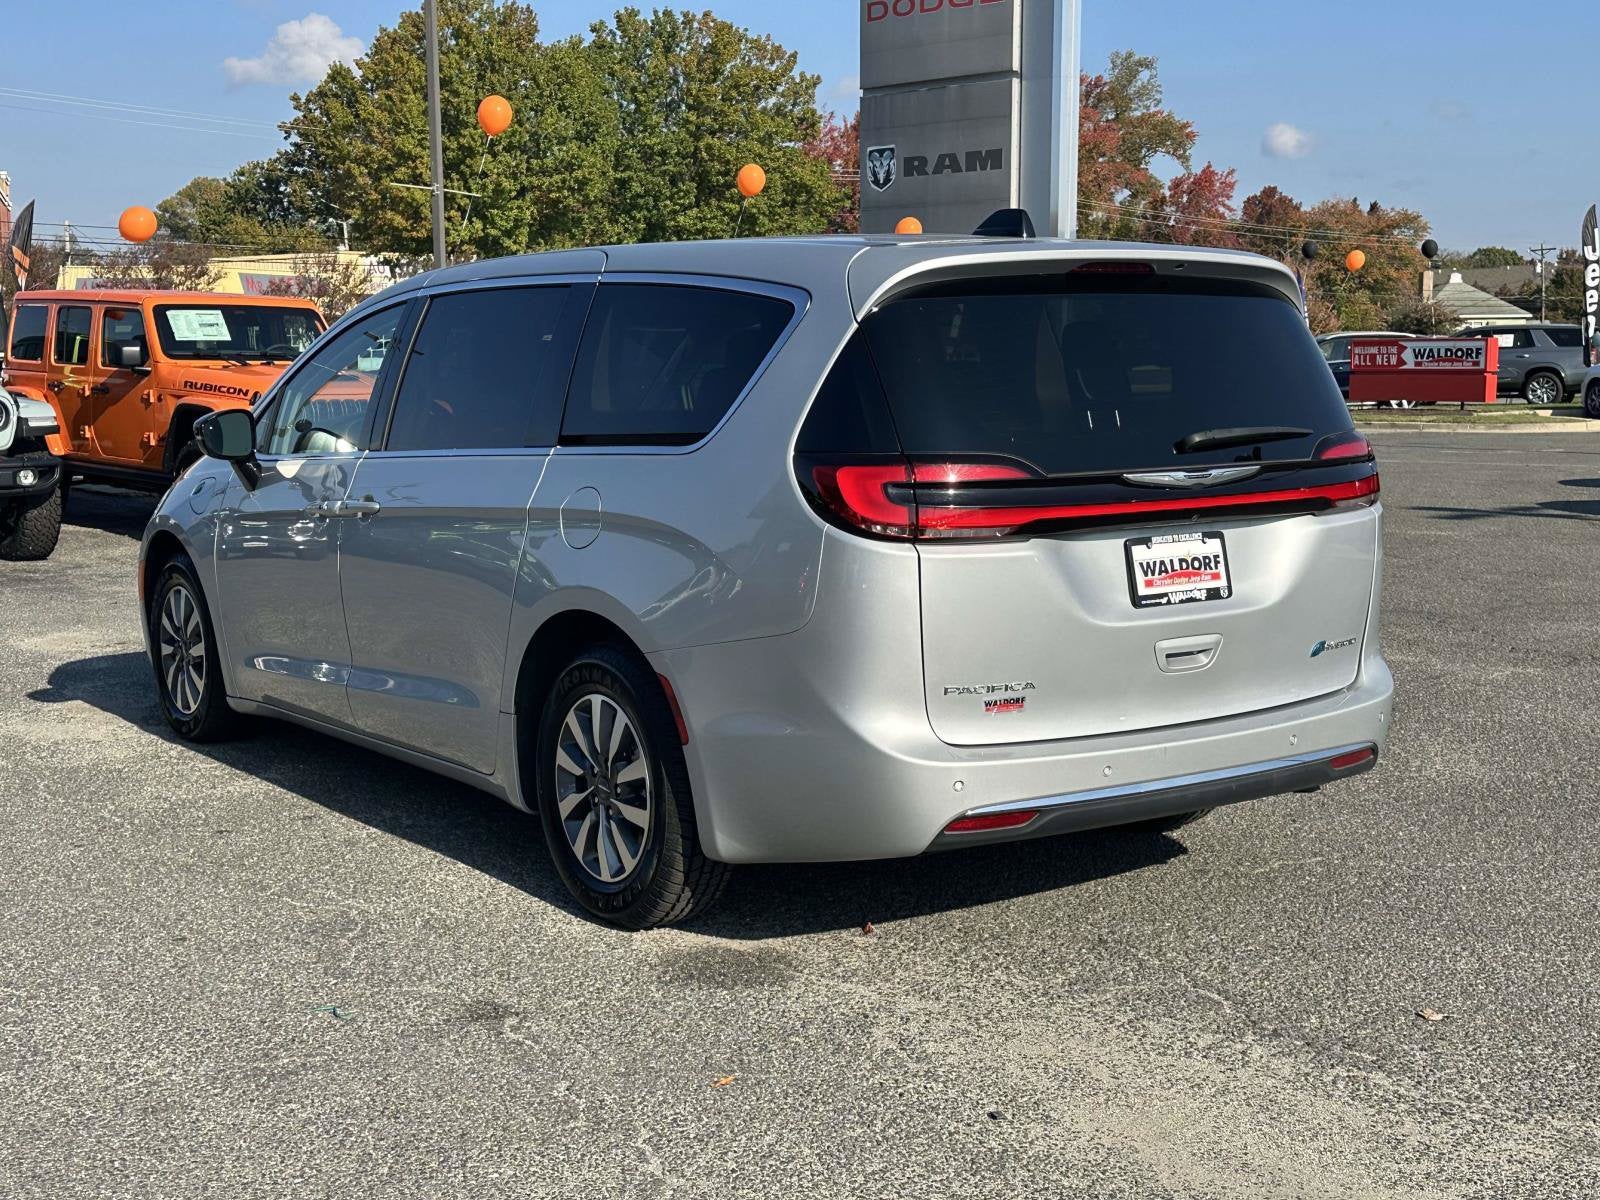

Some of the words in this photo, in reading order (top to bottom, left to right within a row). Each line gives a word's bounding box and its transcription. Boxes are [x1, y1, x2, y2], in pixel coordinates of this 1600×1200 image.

[866, 0, 1004, 23] DOD
[903, 148, 1003, 178] RAM
[1354, 346, 1379, 354] WELCOME
[1380, 346, 1387, 354] TO
[1388, 346, 1398, 354] THE
[1412, 347, 1483, 360] WALDORF
[1354, 354, 1372, 366] ALL
[1376, 354, 1398, 366] NEW
[183, 380, 250, 397] RUBICON
[1138, 554, 1221, 577] WALDORF
[1153, 577, 1173, 587] Chrysler
[1174, 577, 1188, 585] Dodge
[1188, 575, 1201, 584] Jeep
[943, 682, 1036, 696] PACIFICA
[984, 696, 1026, 708] WALDORF
